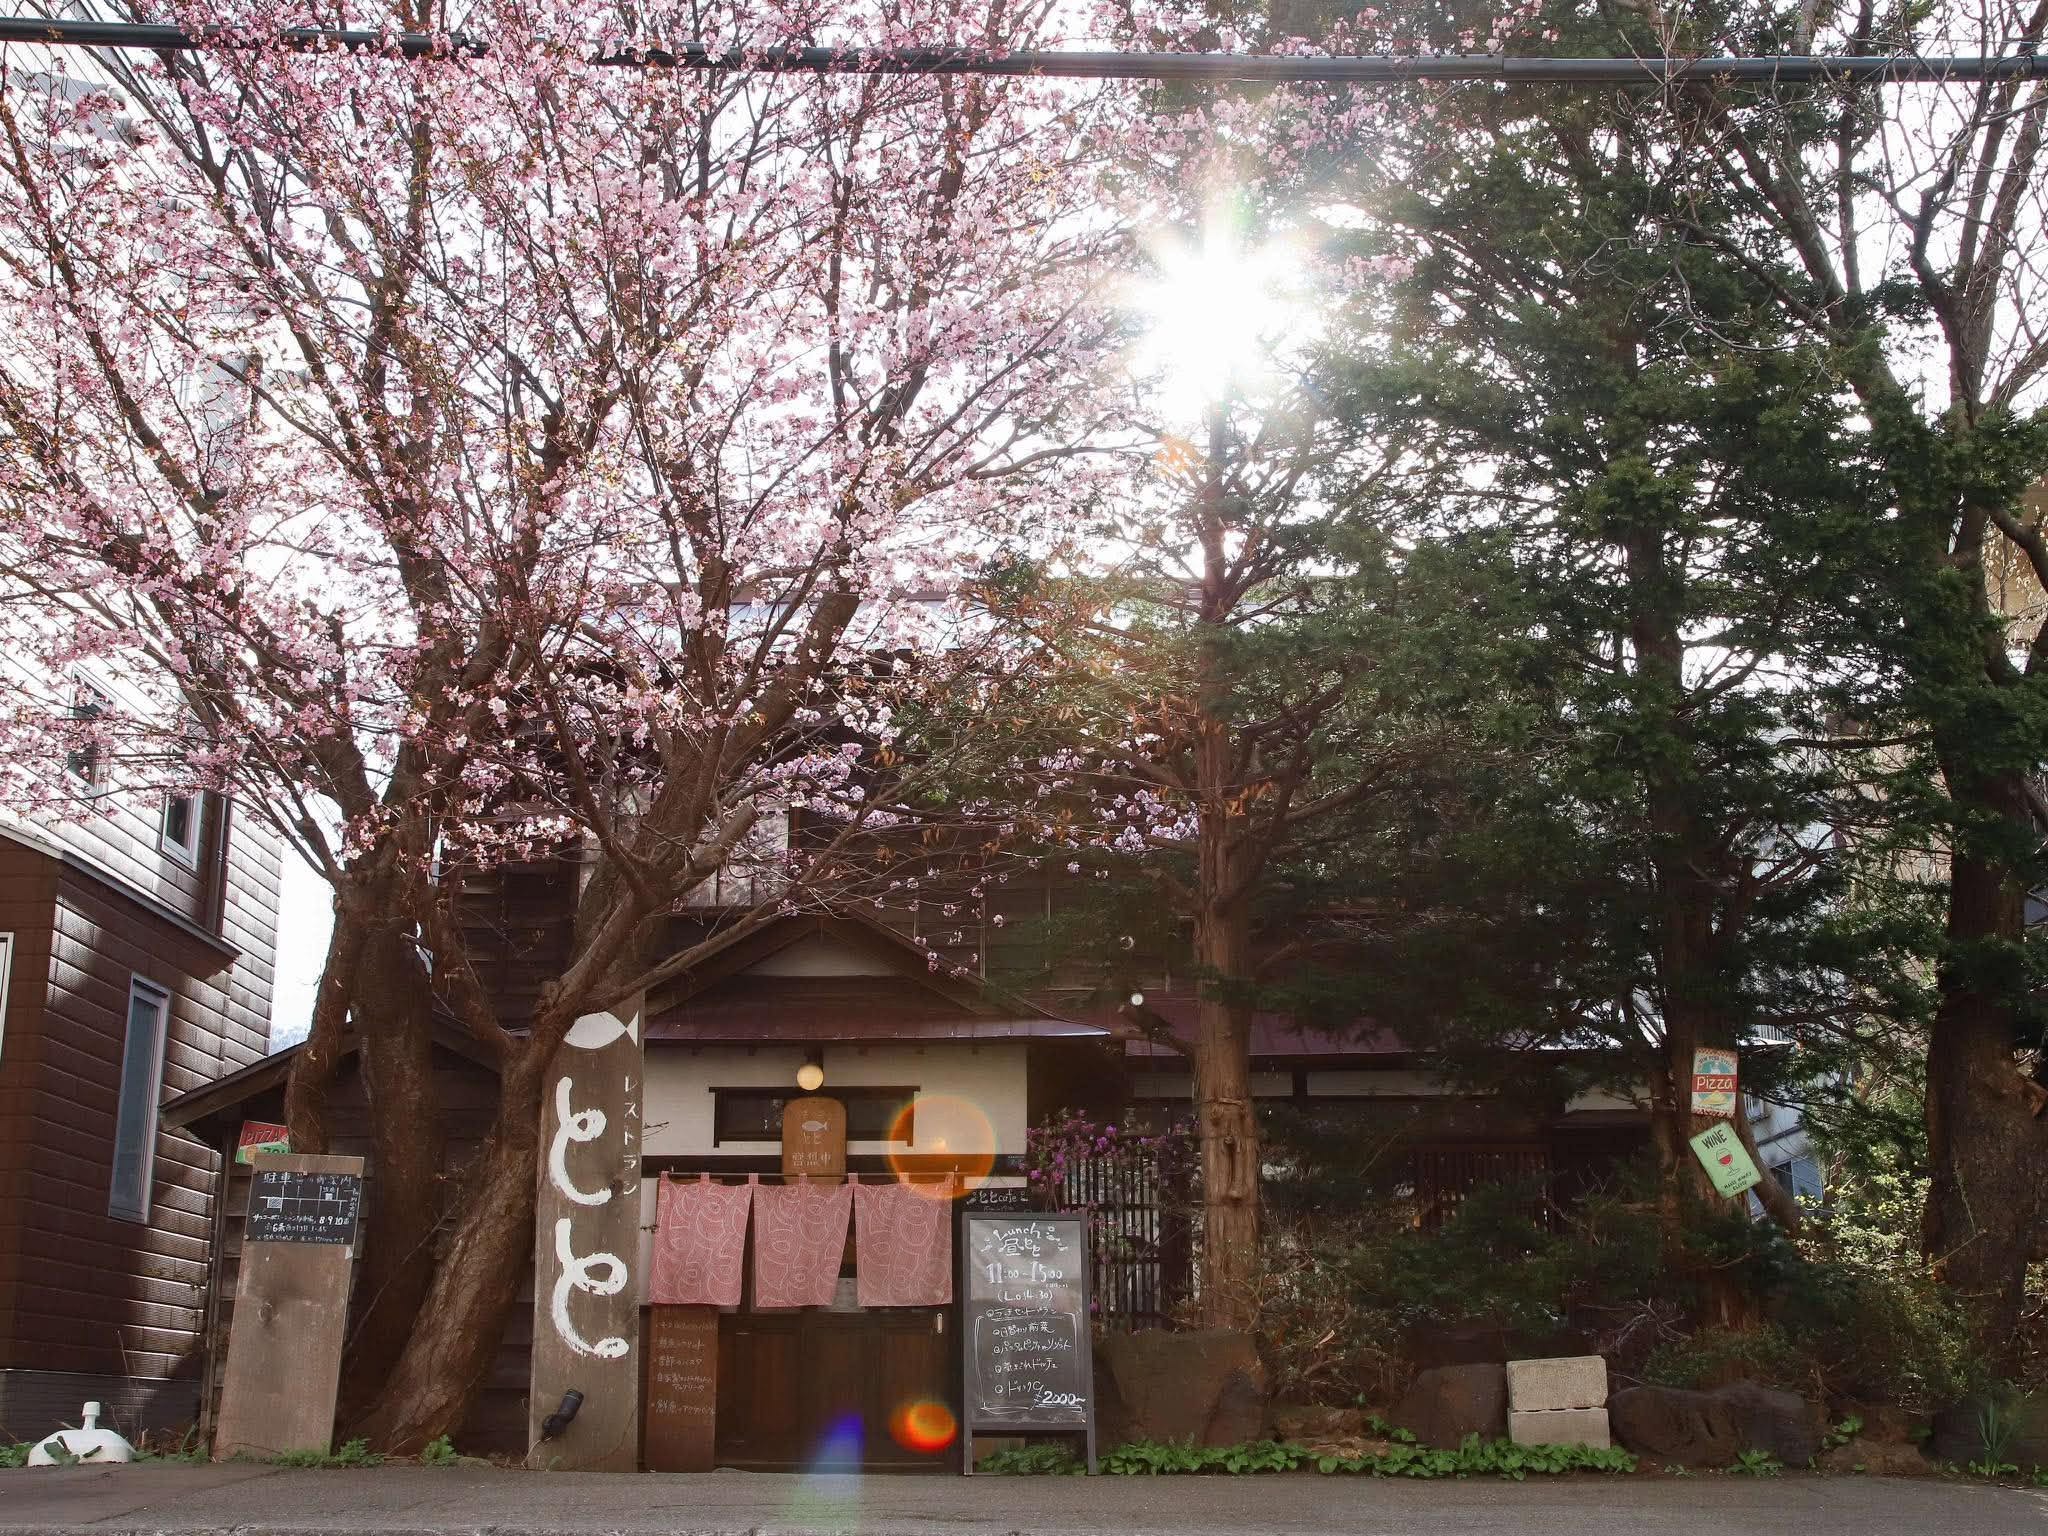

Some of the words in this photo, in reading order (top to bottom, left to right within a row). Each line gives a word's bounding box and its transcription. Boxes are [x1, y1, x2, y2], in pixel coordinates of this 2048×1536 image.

[1697, 1076, 1733, 1091] Pizza
[624, 1075, 639, 1196] レストラン
[1702, 1129, 1727, 1149] WINE
[549, 1075, 629, 1359] とと
[993, 1222, 1041, 1240] Lunch
[999, 1238, 1041, 1257] 昼とと
